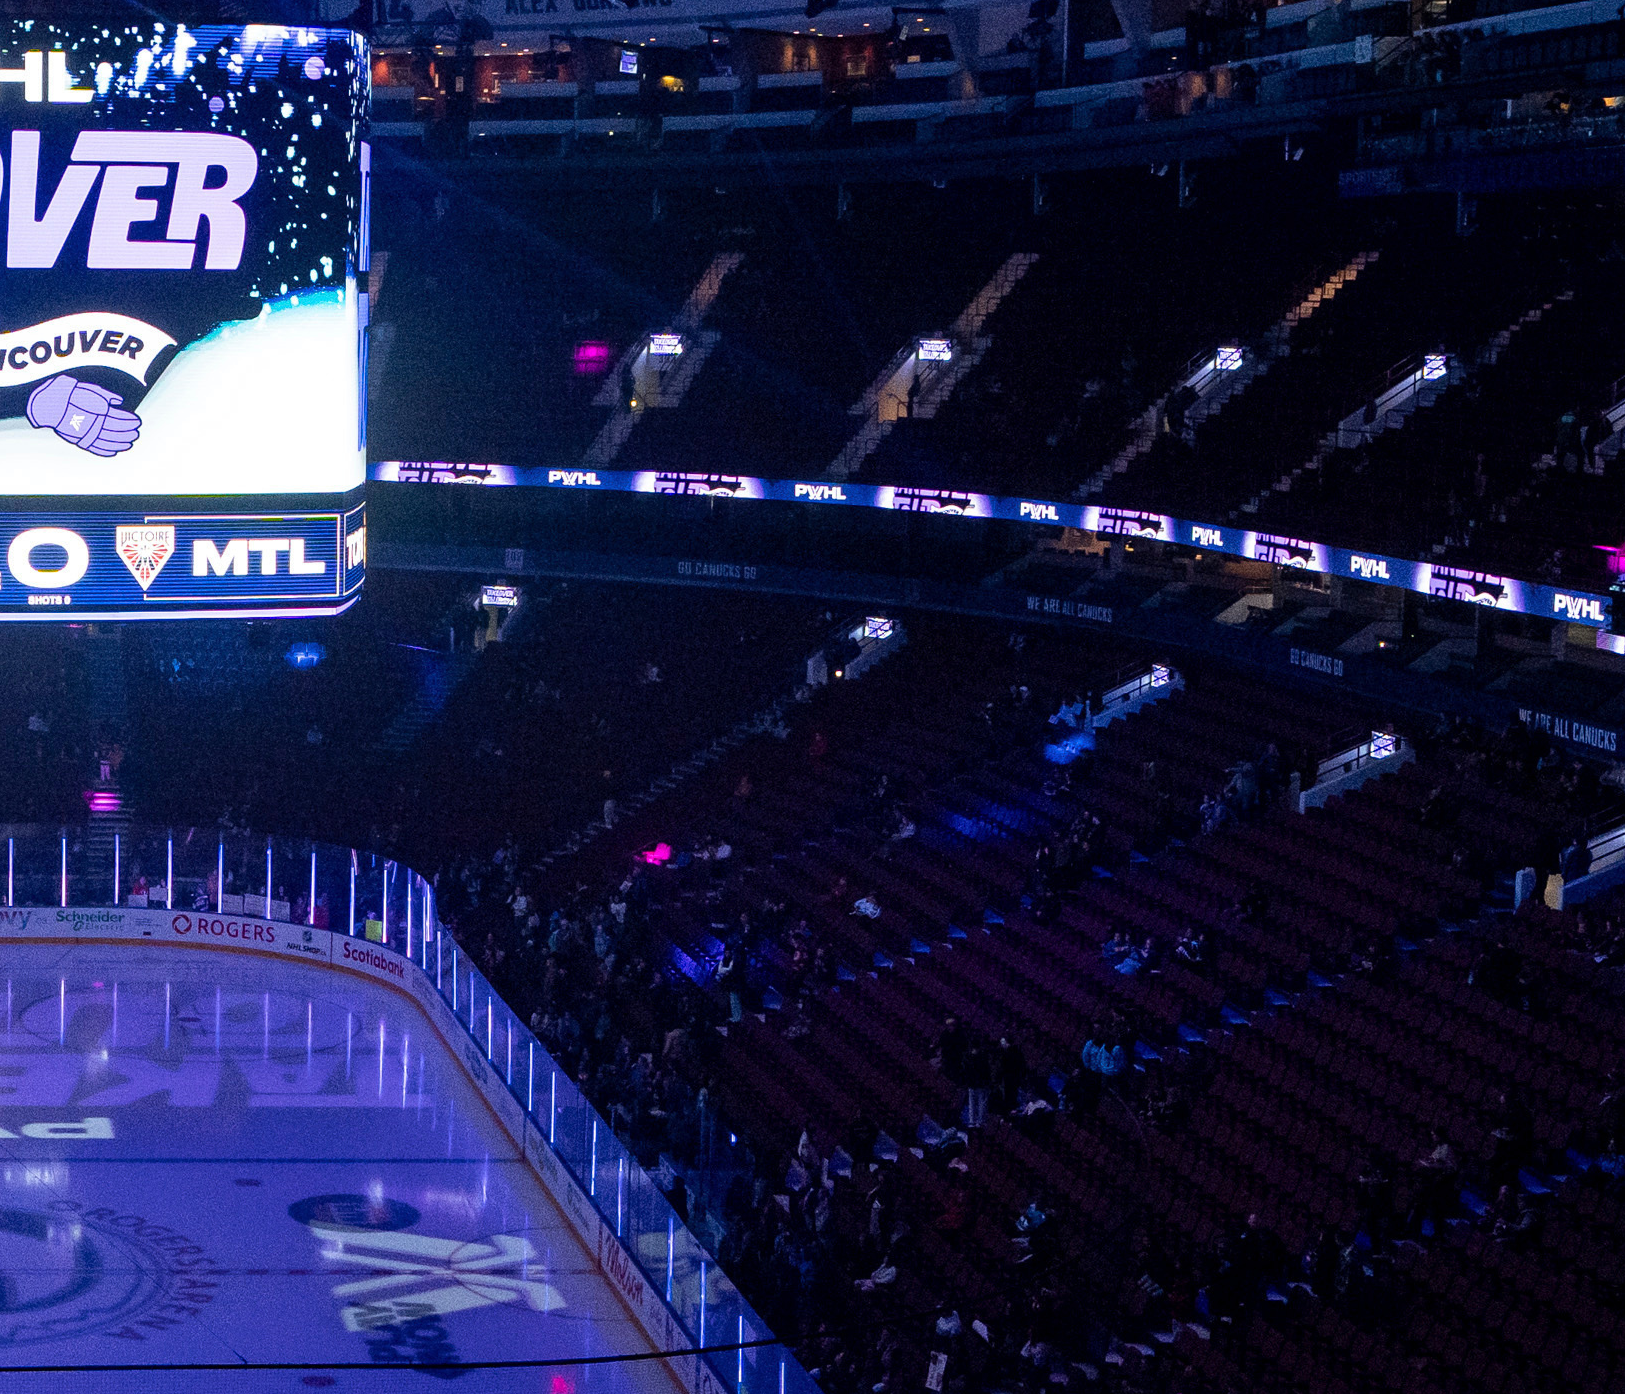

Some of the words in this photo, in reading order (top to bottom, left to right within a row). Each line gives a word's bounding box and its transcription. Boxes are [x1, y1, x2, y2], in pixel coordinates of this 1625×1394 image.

[547, 470, 602, 486] PWHL
[794, 483, 847, 501] PWHL
[1020, 501, 1060, 521] PWHL
[121, 530, 170, 543] VICTOIRE
[1191, 525, 1224, 547] PWHL
[191, 539, 326, 576] MTL
[1350, 554, 1391, 579] PWHL
[28, 595, 58, 605] SHOTS
[1553, 593, 1606, 621] PWHL
[1553, 717, 1570, 740] ALL
[1572, 721, 1617, 752] CANUCKS
[55, 910, 126, 925] Schneider
[197, 918, 277, 944] ROGERS
[342, 942, 406, 980] Scotiabank
